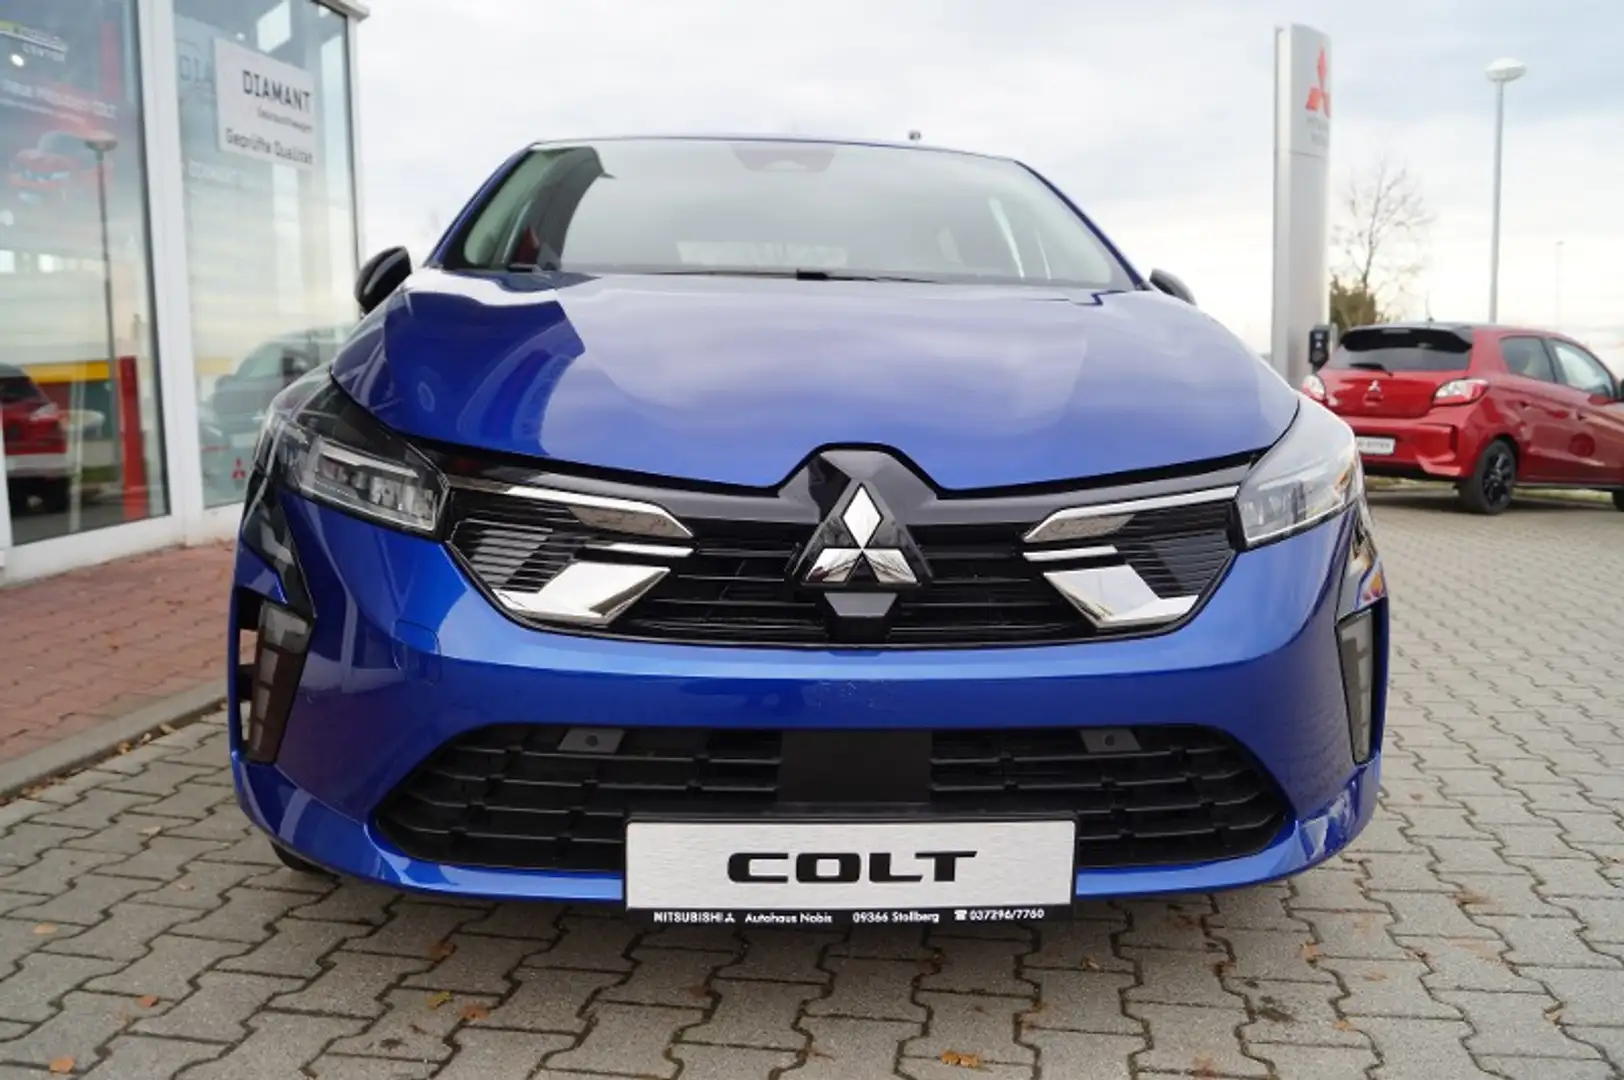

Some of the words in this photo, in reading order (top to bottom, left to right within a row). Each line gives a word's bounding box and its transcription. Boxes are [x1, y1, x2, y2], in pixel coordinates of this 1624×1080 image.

[242, 69, 311, 113] DIAMANT
[727, 850, 978, 883] COLT
[653, 911, 722, 923] MITSUBISHI
[744, 912, 798, 924] Autohaus
[853, 911, 888, 923] 09366
[892, 911, 940, 923] Stollberg
[969, 908, 1045, 921] 037296/7760
